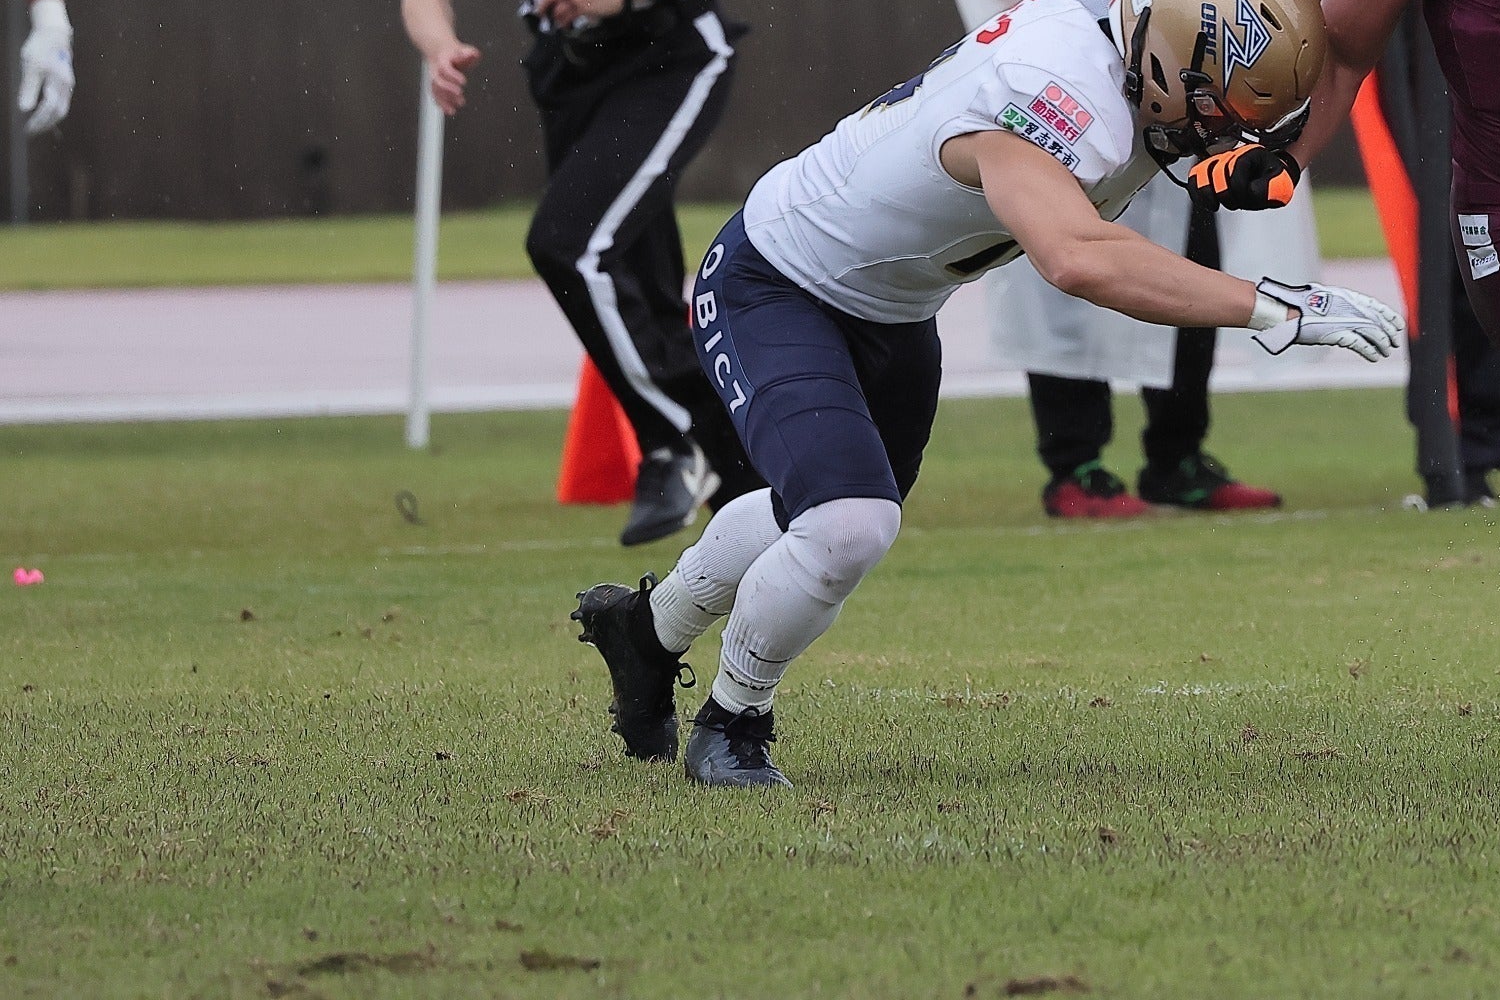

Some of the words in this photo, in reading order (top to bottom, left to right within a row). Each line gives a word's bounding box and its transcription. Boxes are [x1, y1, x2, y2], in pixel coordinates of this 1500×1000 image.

[1031, 98, 1080, 142] 勘定奉行
[1045, 85, 1092, 129] OBC
[1023, 121, 1076, 168] 習志野市
[696, 242, 748, 414] OBIC7
